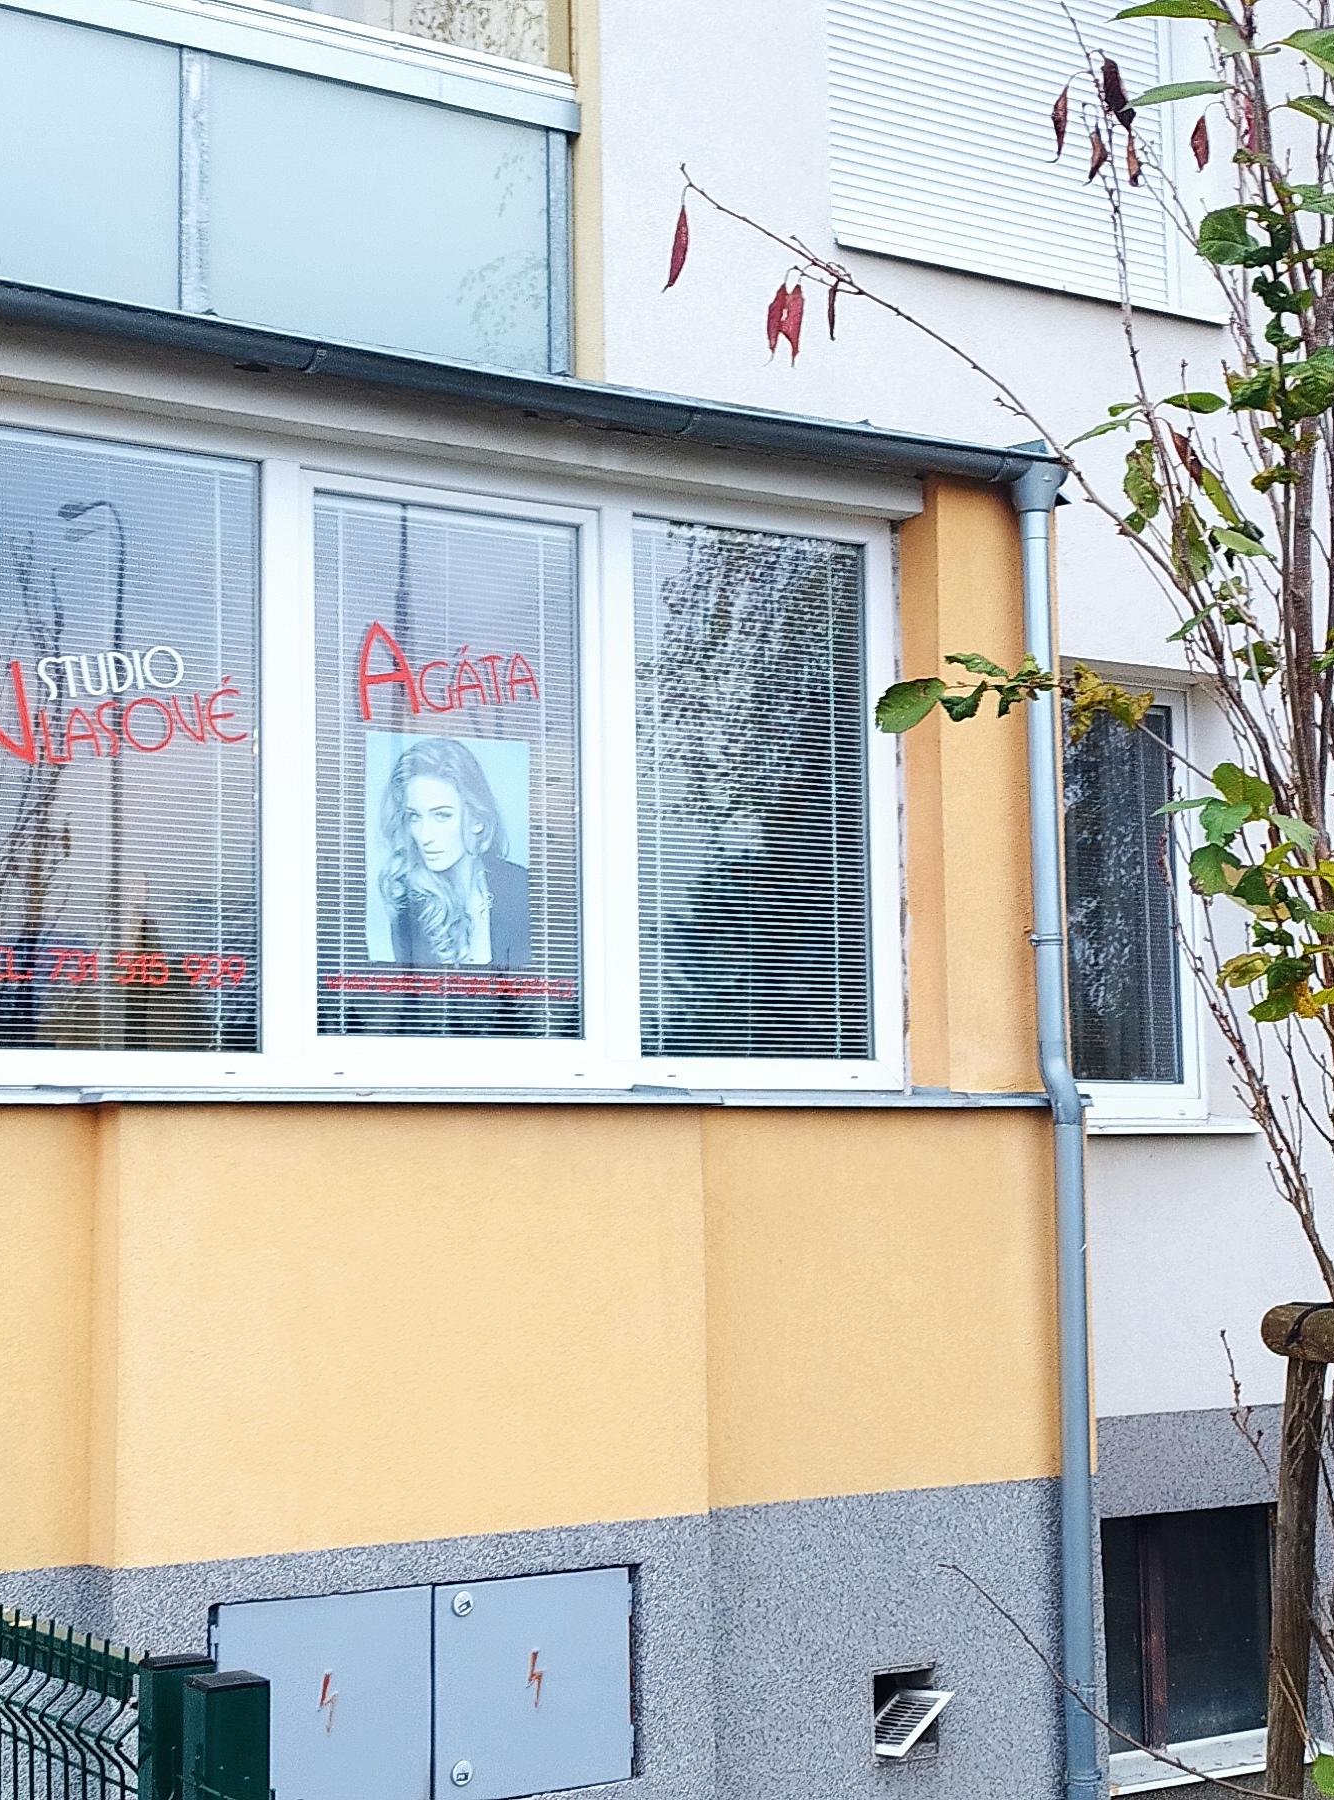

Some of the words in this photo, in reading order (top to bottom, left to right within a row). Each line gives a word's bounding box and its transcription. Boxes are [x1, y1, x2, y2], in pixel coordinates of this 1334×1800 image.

[37, 645, 184, 701] STUDIO
[359, 620, 540, 721] AGÁTA
[47, 949, 99, 983] 731
[114, 952, 169, 985] 515
